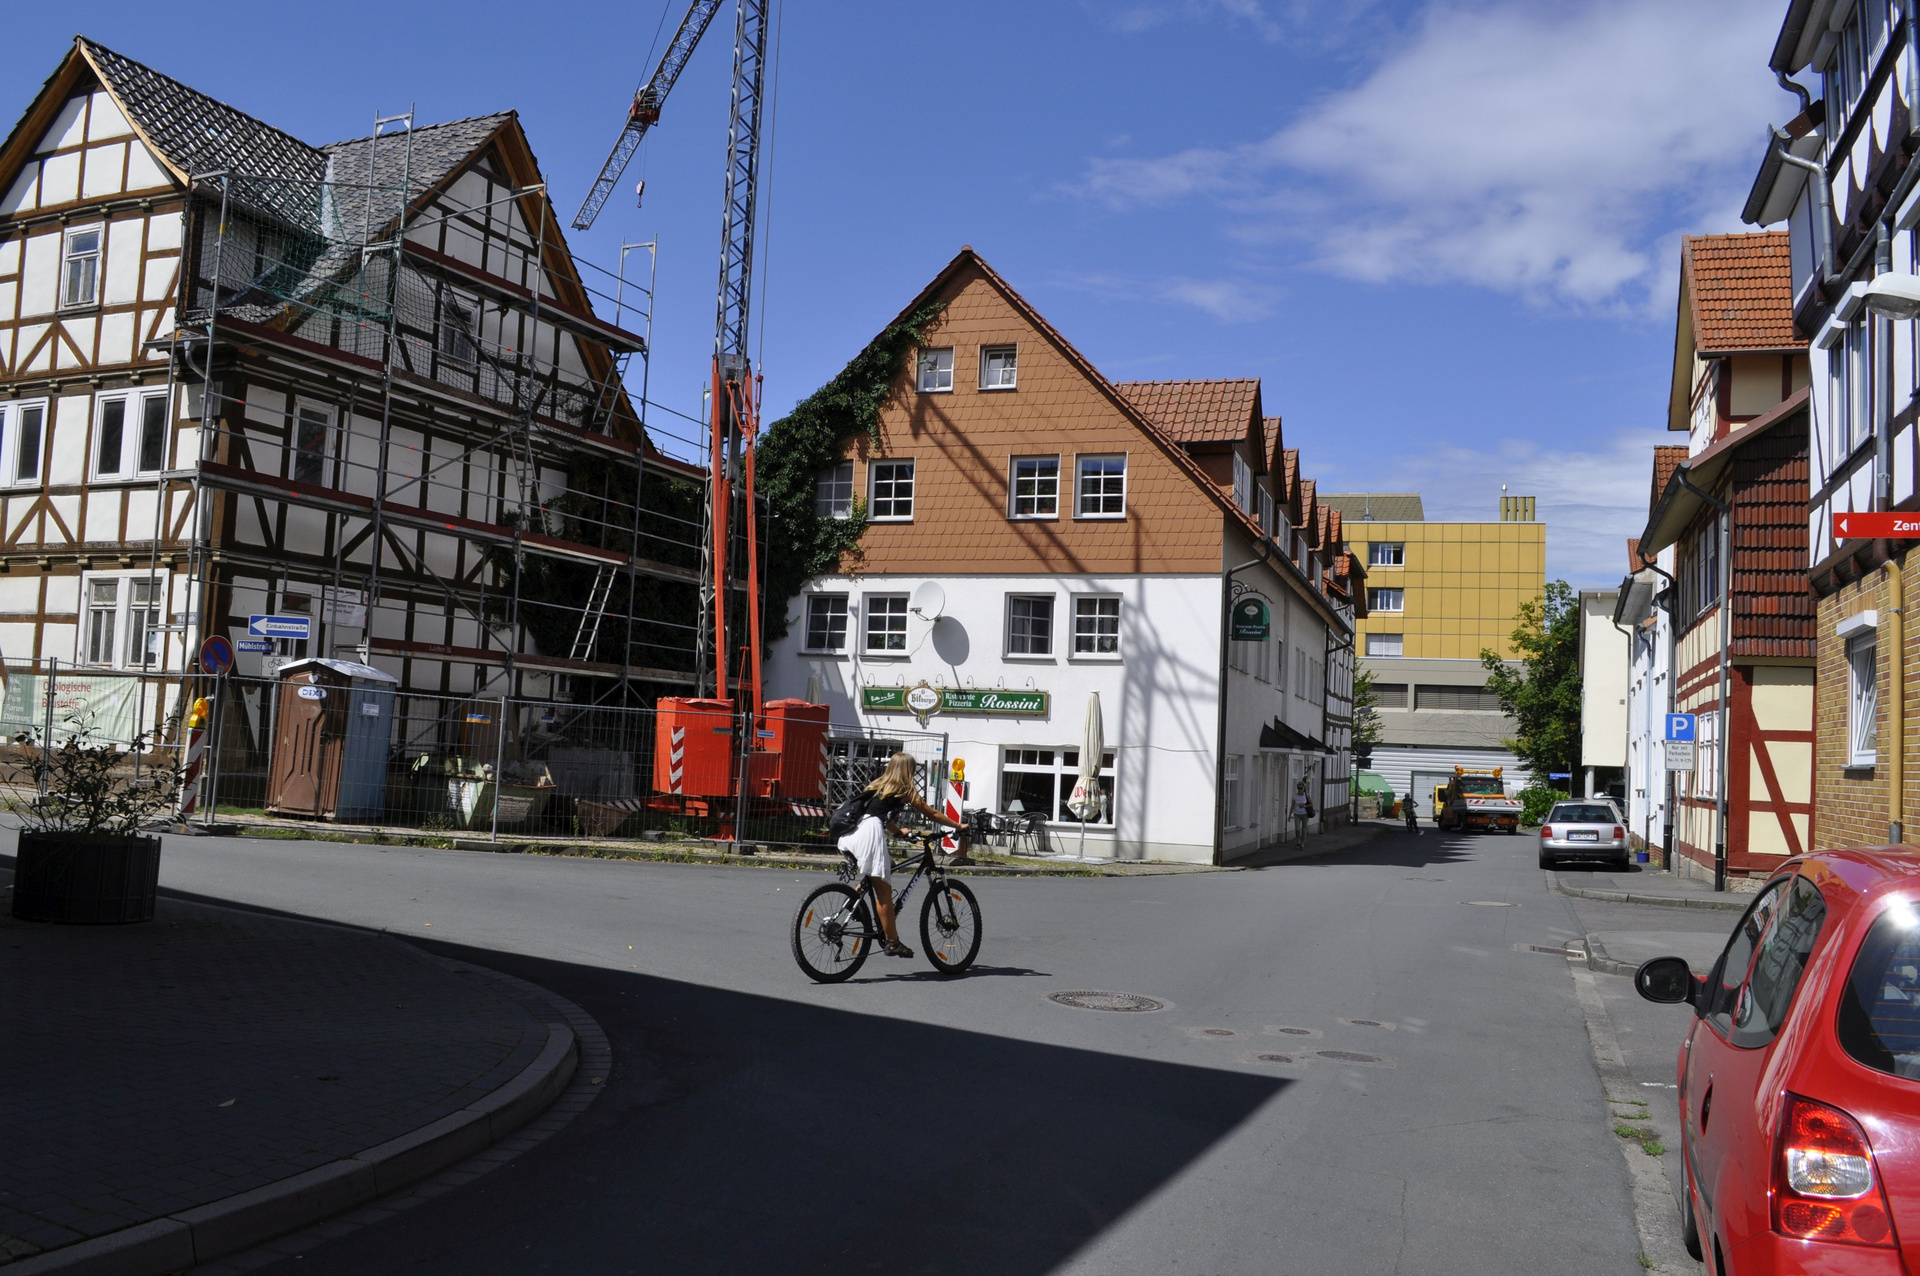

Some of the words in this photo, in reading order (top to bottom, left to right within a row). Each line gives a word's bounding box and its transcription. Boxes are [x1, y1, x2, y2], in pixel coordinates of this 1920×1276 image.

[266, 623, 307, 631] Einbahnstraße
[239, 642, 273, 651] Mühlstraße
[43, 679, 91, 695] Öologische
[42, 698, 79, 709] Bustoffe
[980, 694, 1041, 710] Rossini
[1672, 717, 1688, 738] P
